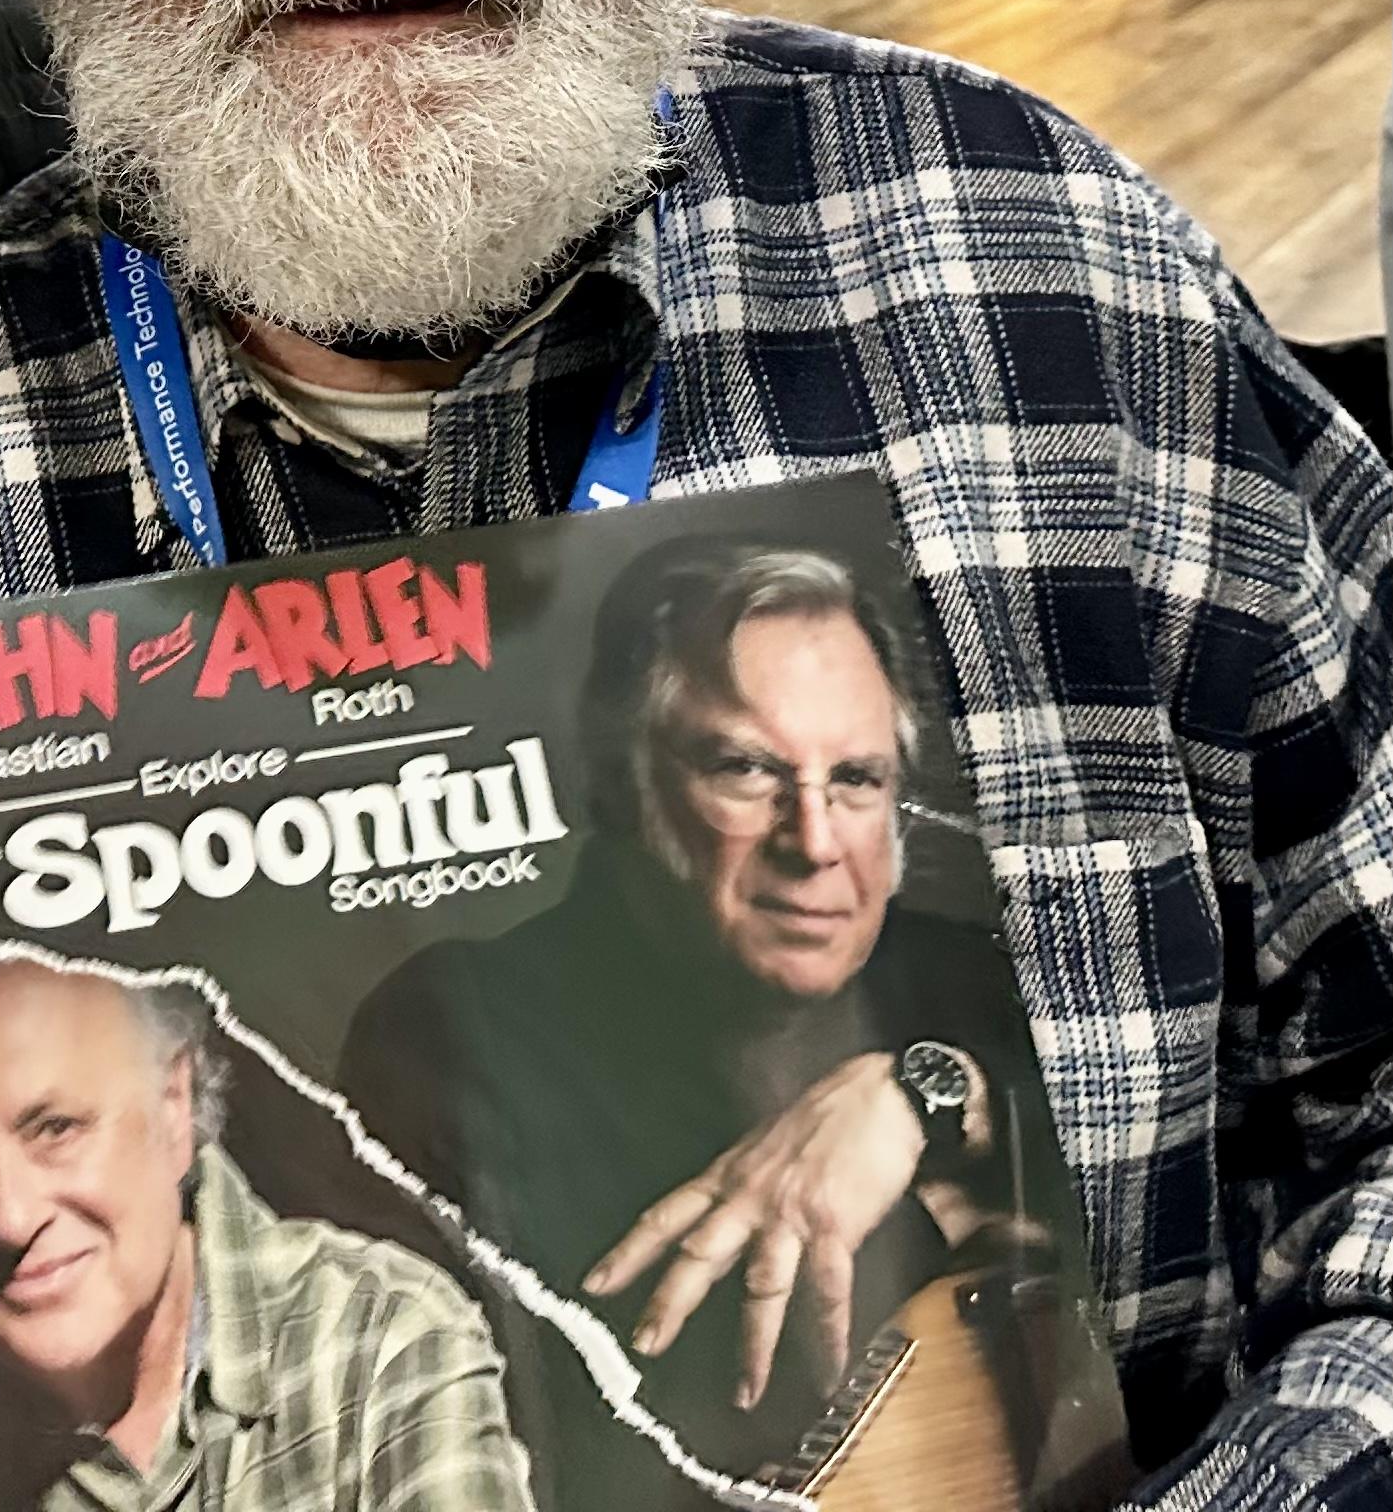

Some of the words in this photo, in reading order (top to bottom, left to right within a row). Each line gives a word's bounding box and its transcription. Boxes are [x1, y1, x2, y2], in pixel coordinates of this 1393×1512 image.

[118, 242, 158, 361] Technolo
[146, 359, 208, 537] Performance
[127, 610, 196, 674] and
[192, 556, 492, 700] ARLEN
[310, 677, 416, 727] Roth
[139, 746, 290, 798] Explore
[2, 736, 570, 934] Spoonful
[328, 848, 543, 915] Songbook
